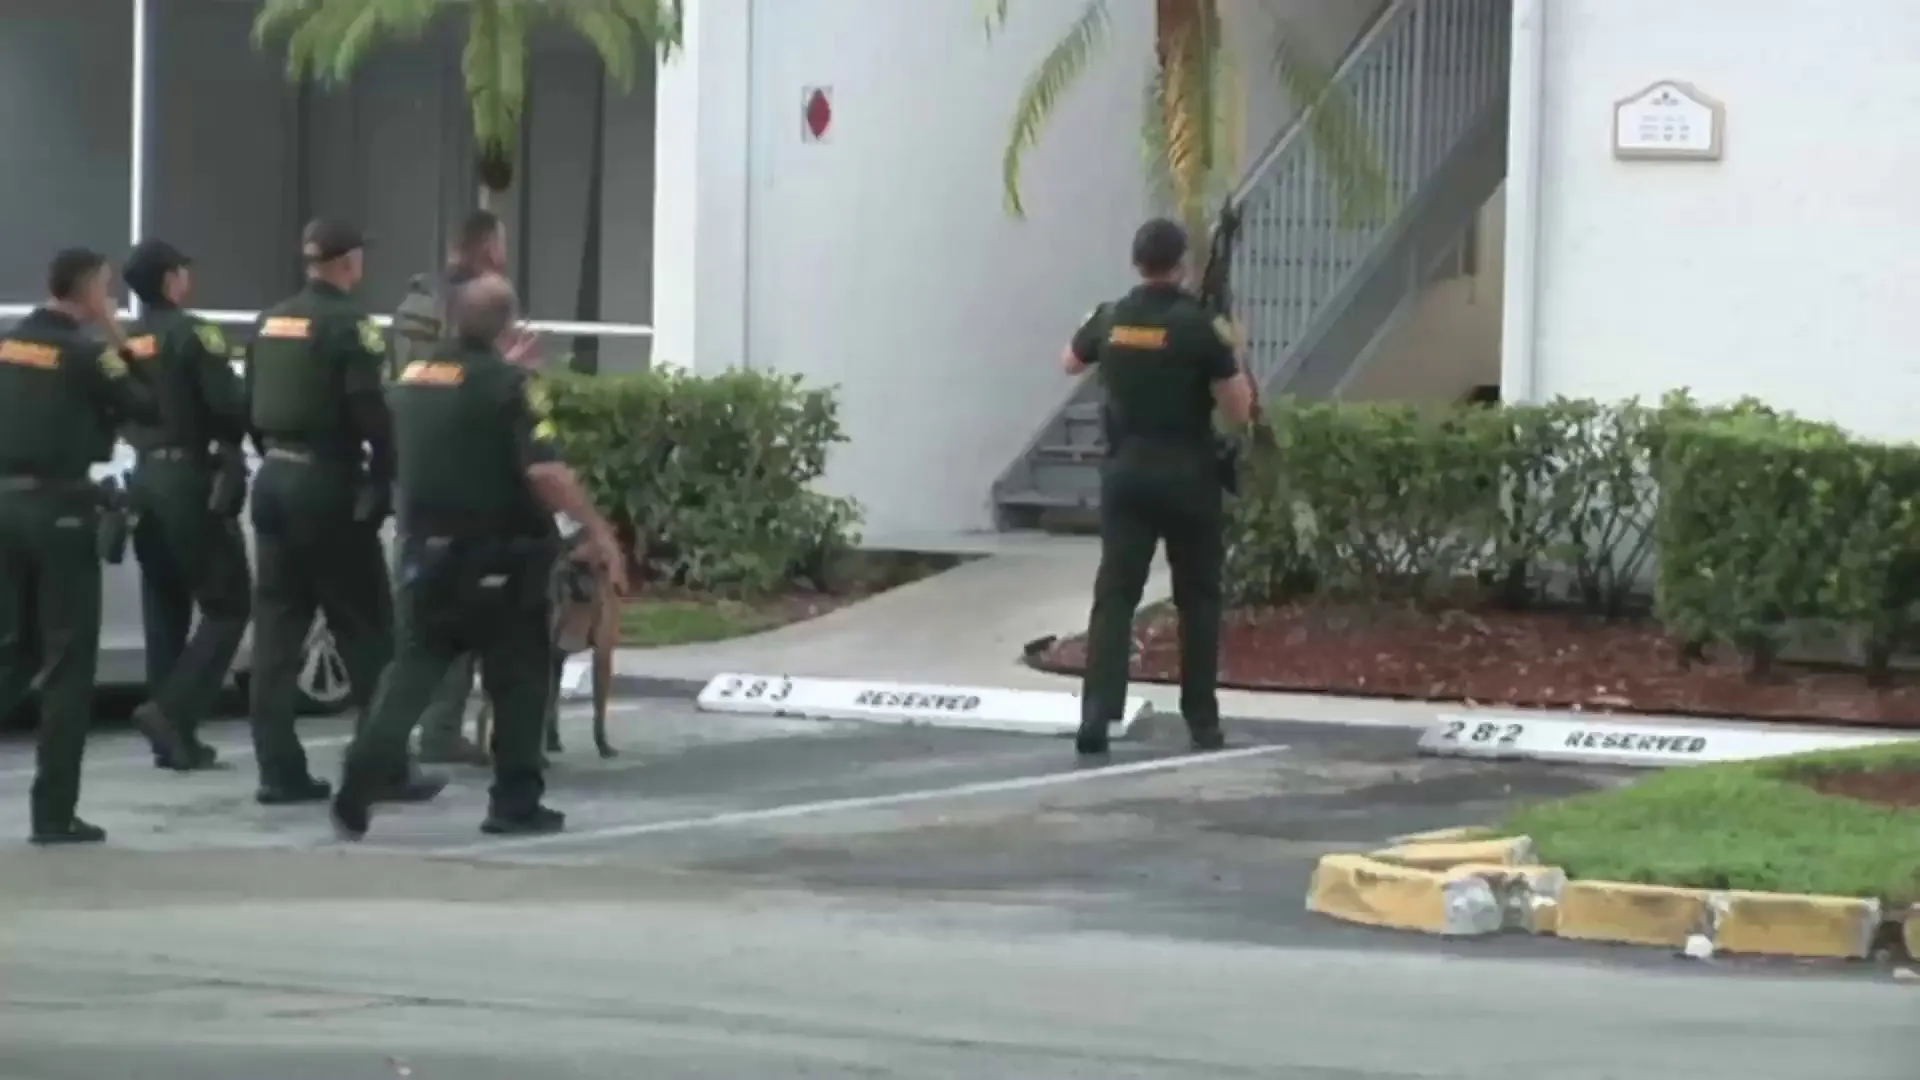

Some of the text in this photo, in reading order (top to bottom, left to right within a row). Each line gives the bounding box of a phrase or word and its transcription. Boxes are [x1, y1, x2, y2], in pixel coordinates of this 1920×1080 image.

[719, 675, 982, 711] 283 RESERVED
[1442, 721, 1707, 753] 282 RESERVED
